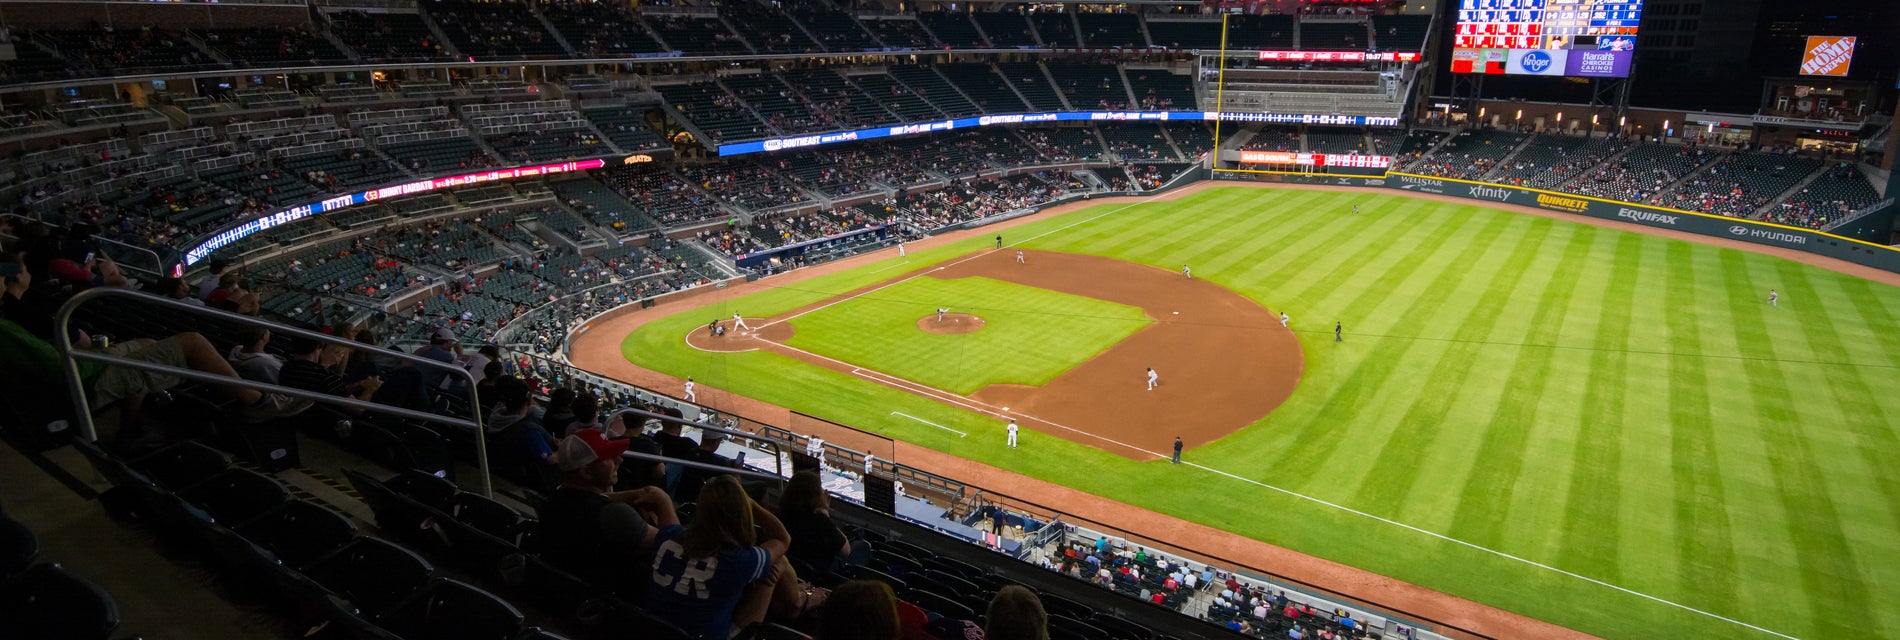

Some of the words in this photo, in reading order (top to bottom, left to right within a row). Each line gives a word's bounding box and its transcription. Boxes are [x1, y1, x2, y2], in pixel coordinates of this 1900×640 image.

[1464, 0, 1475, 9] NL
[1461, 24, 1471, 34] AL
[1802, 37, 1854, 74] HOME
[1810, 40, 1830, 57] THE
[1522, 53, 1550, 71] Kroger
[1819, 51, 1852, 75] DEPOT
[783, 136, 820, 148] SOUTHEAST
[1401, 176, 1443, 187] WELLSTAR
[369, 190, 378, 201] 53
[378, 185, 402, 199] JOHNNY
[402, 180, 433, 194] BARBATO
[1468, 184, 1512, 201] xfinity
[1537, 193, 1589, 209] QUIKRETE
[1618, 207, 1677, 225] EQUIFAX
[1751, 229, 1807, 245] HYUNDAI
